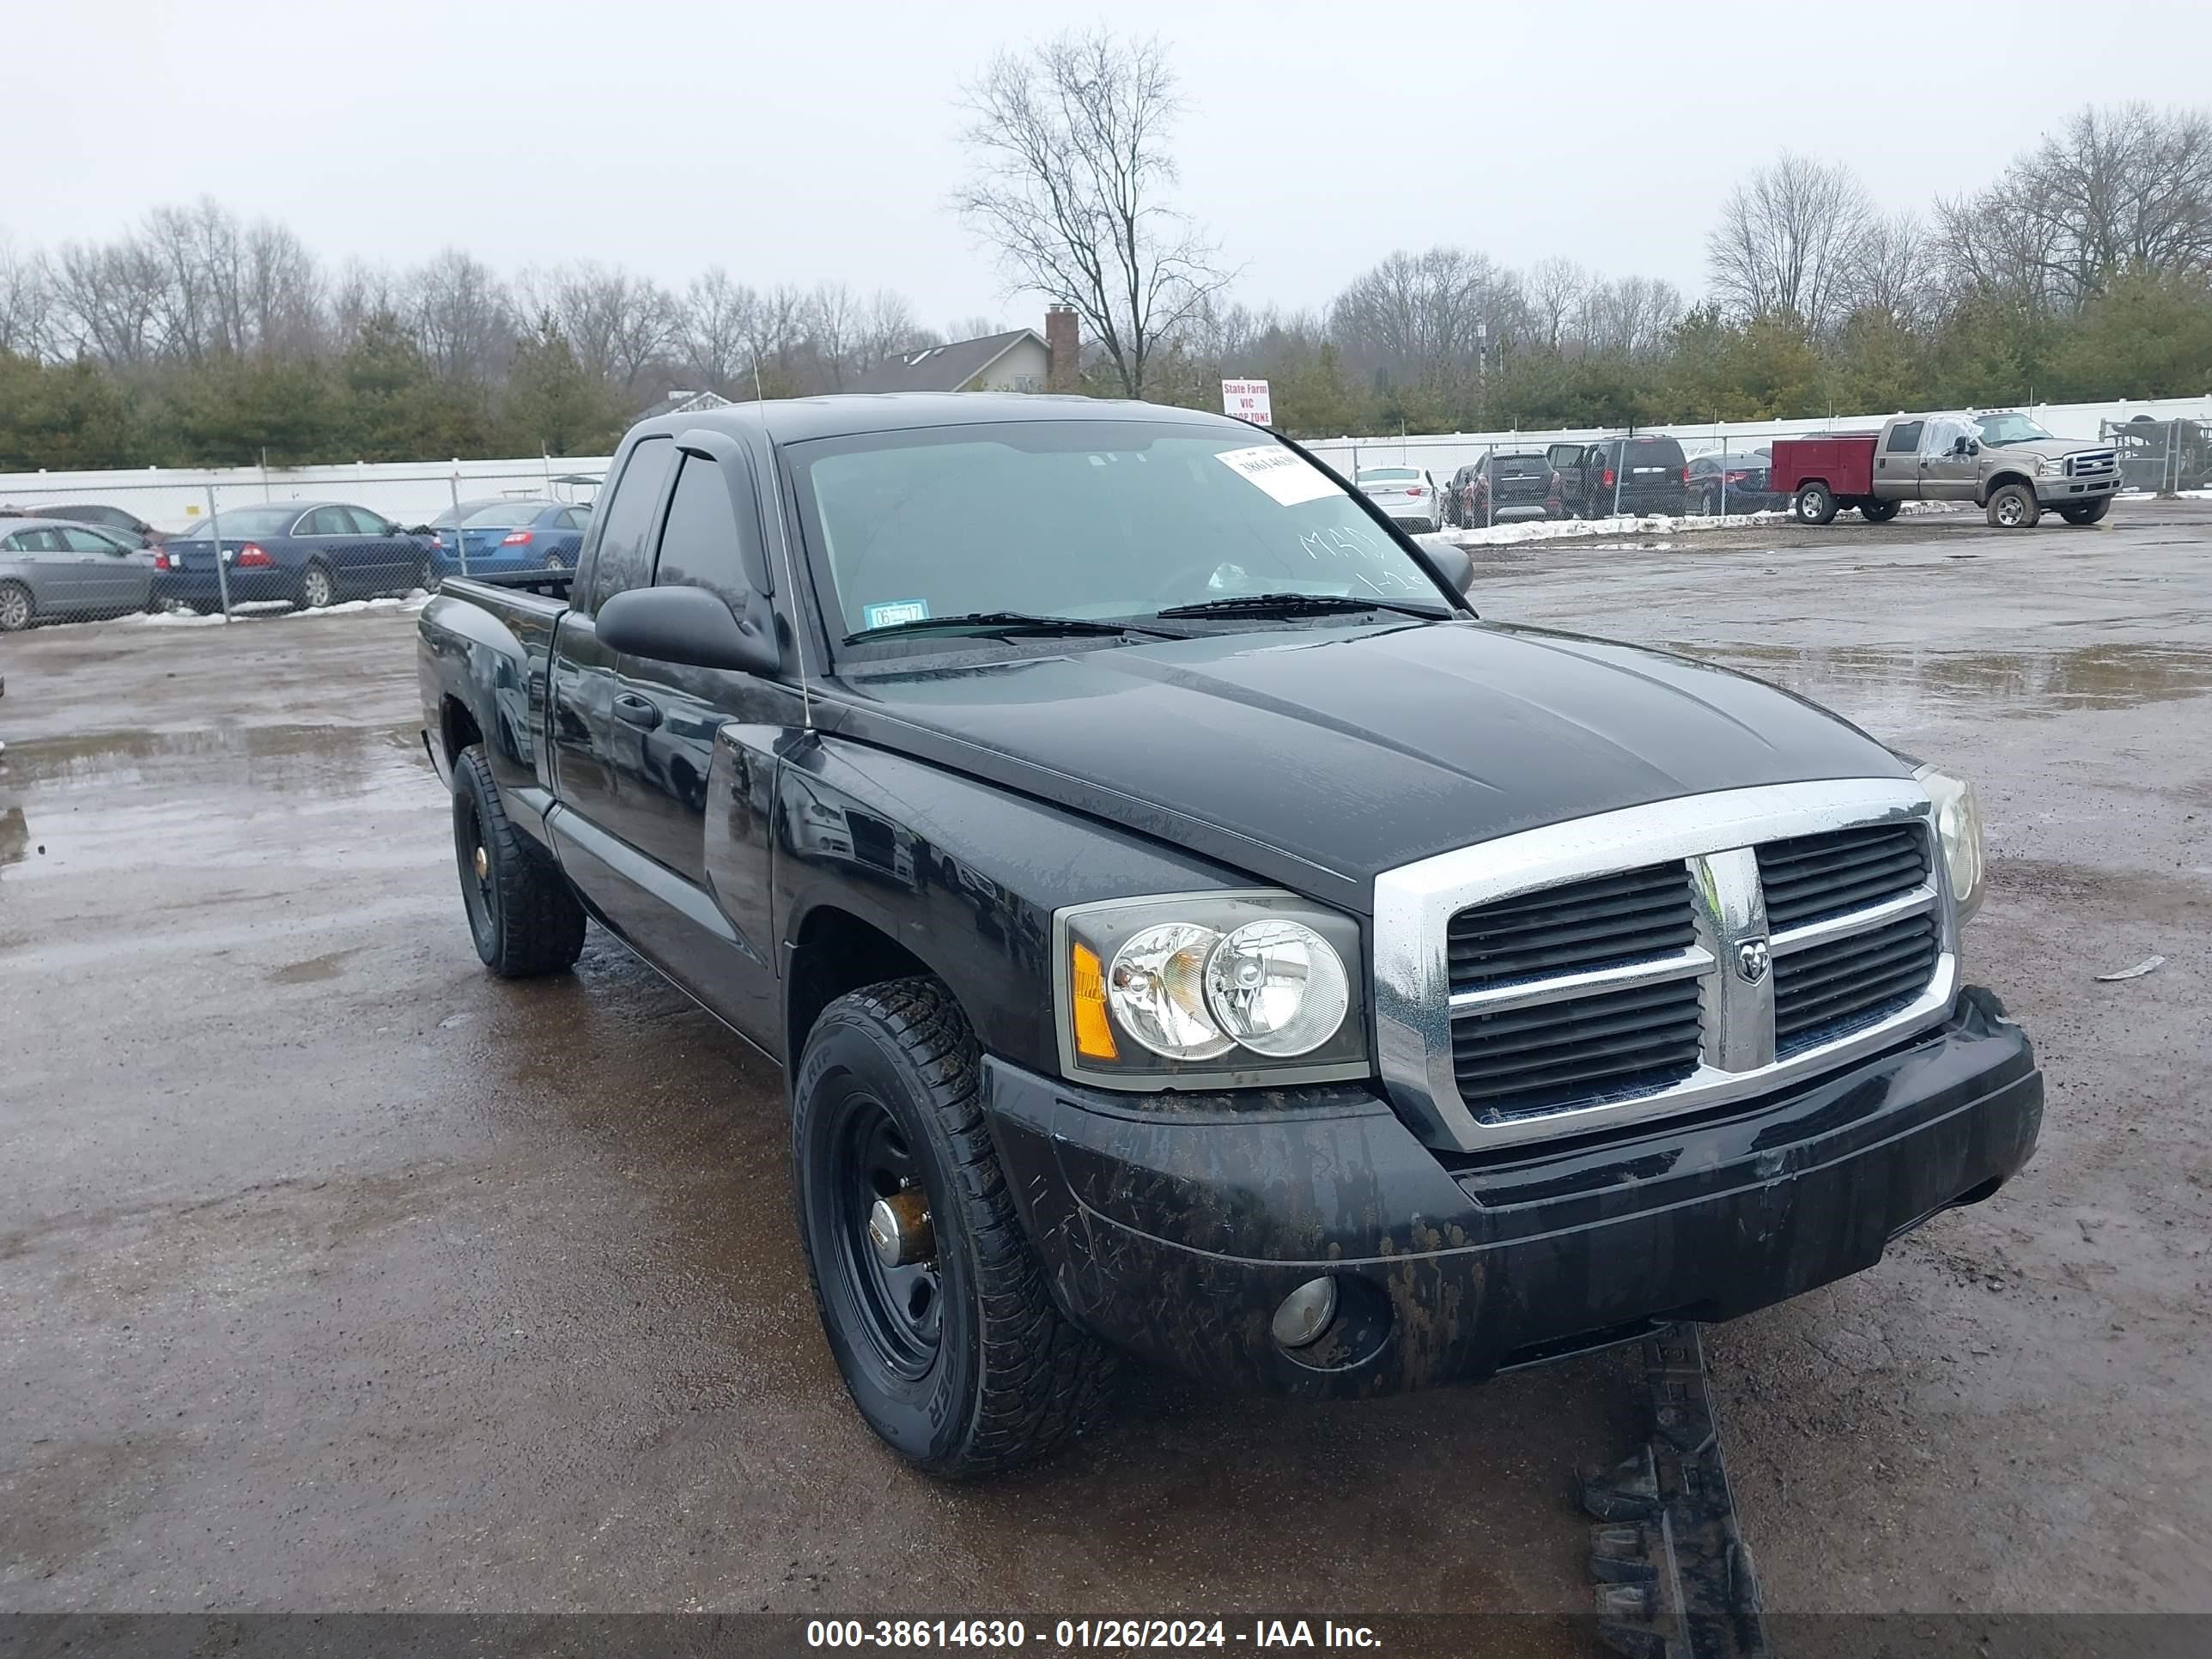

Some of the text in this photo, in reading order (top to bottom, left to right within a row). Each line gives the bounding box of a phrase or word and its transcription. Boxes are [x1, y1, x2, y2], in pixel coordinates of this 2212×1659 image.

[1224, 384, 1267, 394] State Farm
[1239, 398, 1255, 408] VIC
[1250, 412, 1270, 422] ZONE
[876, 605, 919, 626] 06 17
